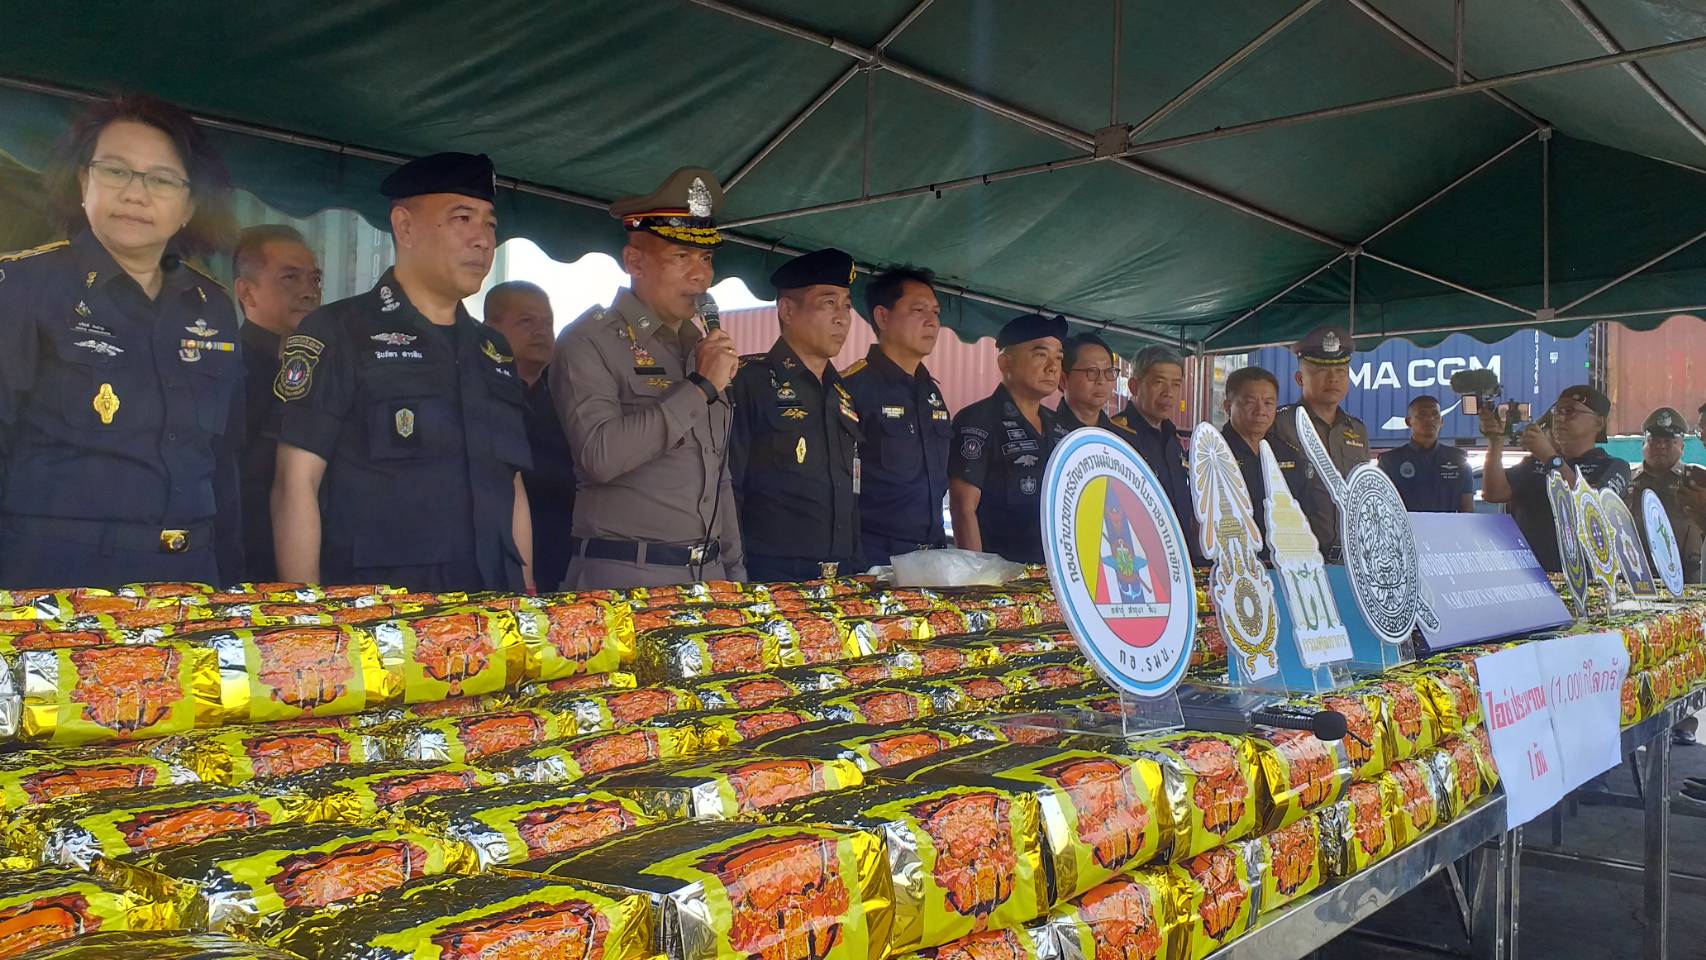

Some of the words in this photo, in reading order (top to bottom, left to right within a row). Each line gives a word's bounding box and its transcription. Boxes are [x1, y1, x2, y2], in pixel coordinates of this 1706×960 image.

[1119, 647, 1175, 673] กอ.รมน.
[1583, 657, 1620, 695] กิโลกรั
